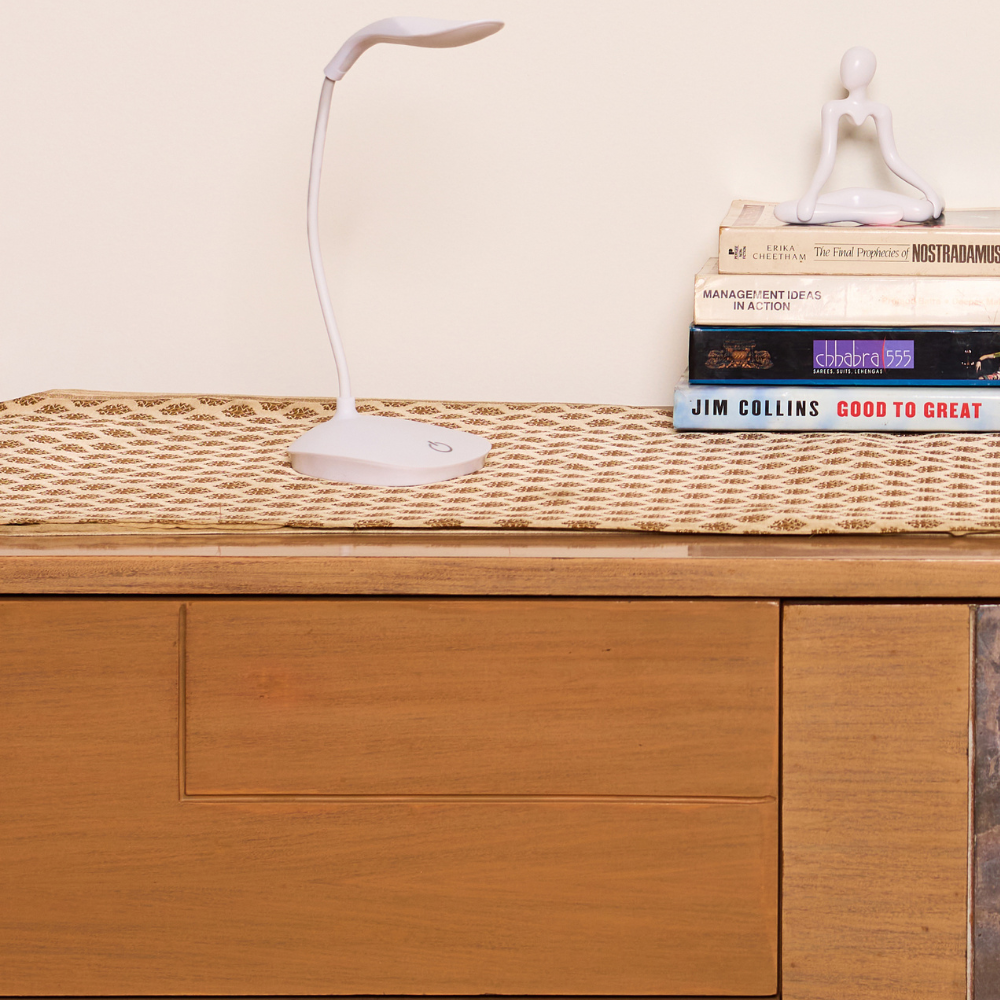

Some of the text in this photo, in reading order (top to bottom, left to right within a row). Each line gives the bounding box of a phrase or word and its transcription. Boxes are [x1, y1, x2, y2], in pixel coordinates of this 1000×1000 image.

[752, 252, 806, 260] CHEETHAM
[814, 246, 830, 257] The
[833, 246, 854, 257] Final
[857, 246, 899, 259] Prophecies
[901, 246, 910, 260] of
[702, 289, 822, 300] MANAGEMENT IDEAS
[733, 301, 791, 311] IN ACTION
[815, 340, 912, 368] chhabra 555
[691, 399, 982, 419] JIM COLLINS GOOD TO GREAT
